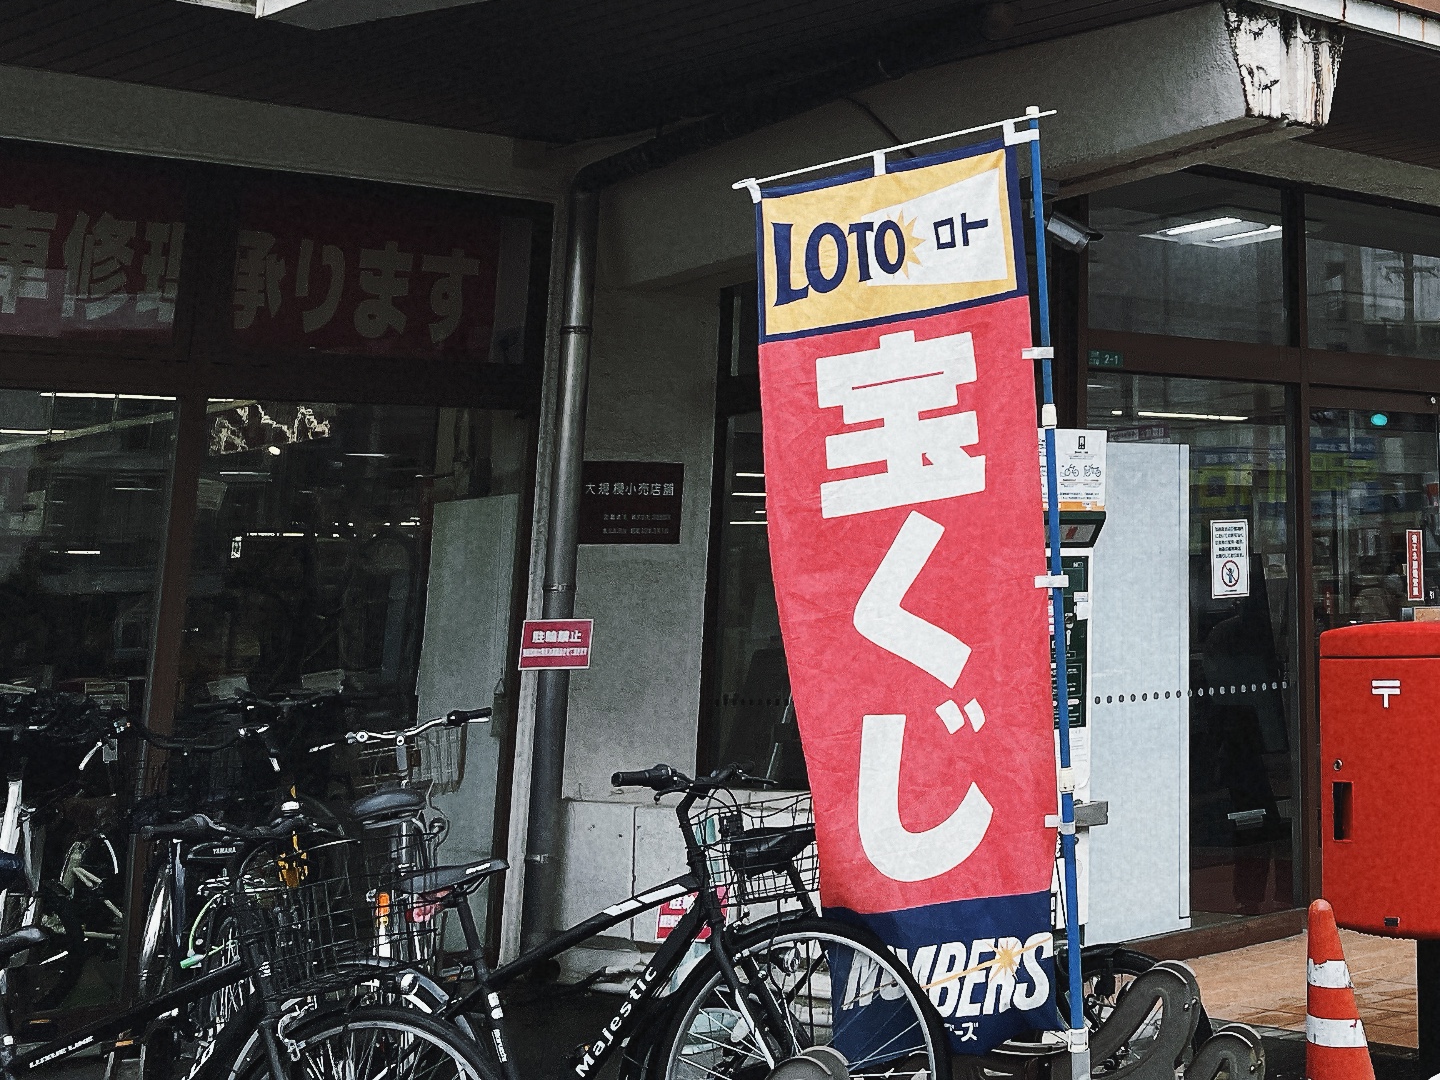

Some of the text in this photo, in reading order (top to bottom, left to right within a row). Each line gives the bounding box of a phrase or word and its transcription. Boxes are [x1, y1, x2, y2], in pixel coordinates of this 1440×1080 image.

[771, 220, 906, 308] LOTO
[933, 212, 989, 251] ロト
[815, 329, 994, 883] 宝くじ
[575, 966, 658, 1078] Majestic
